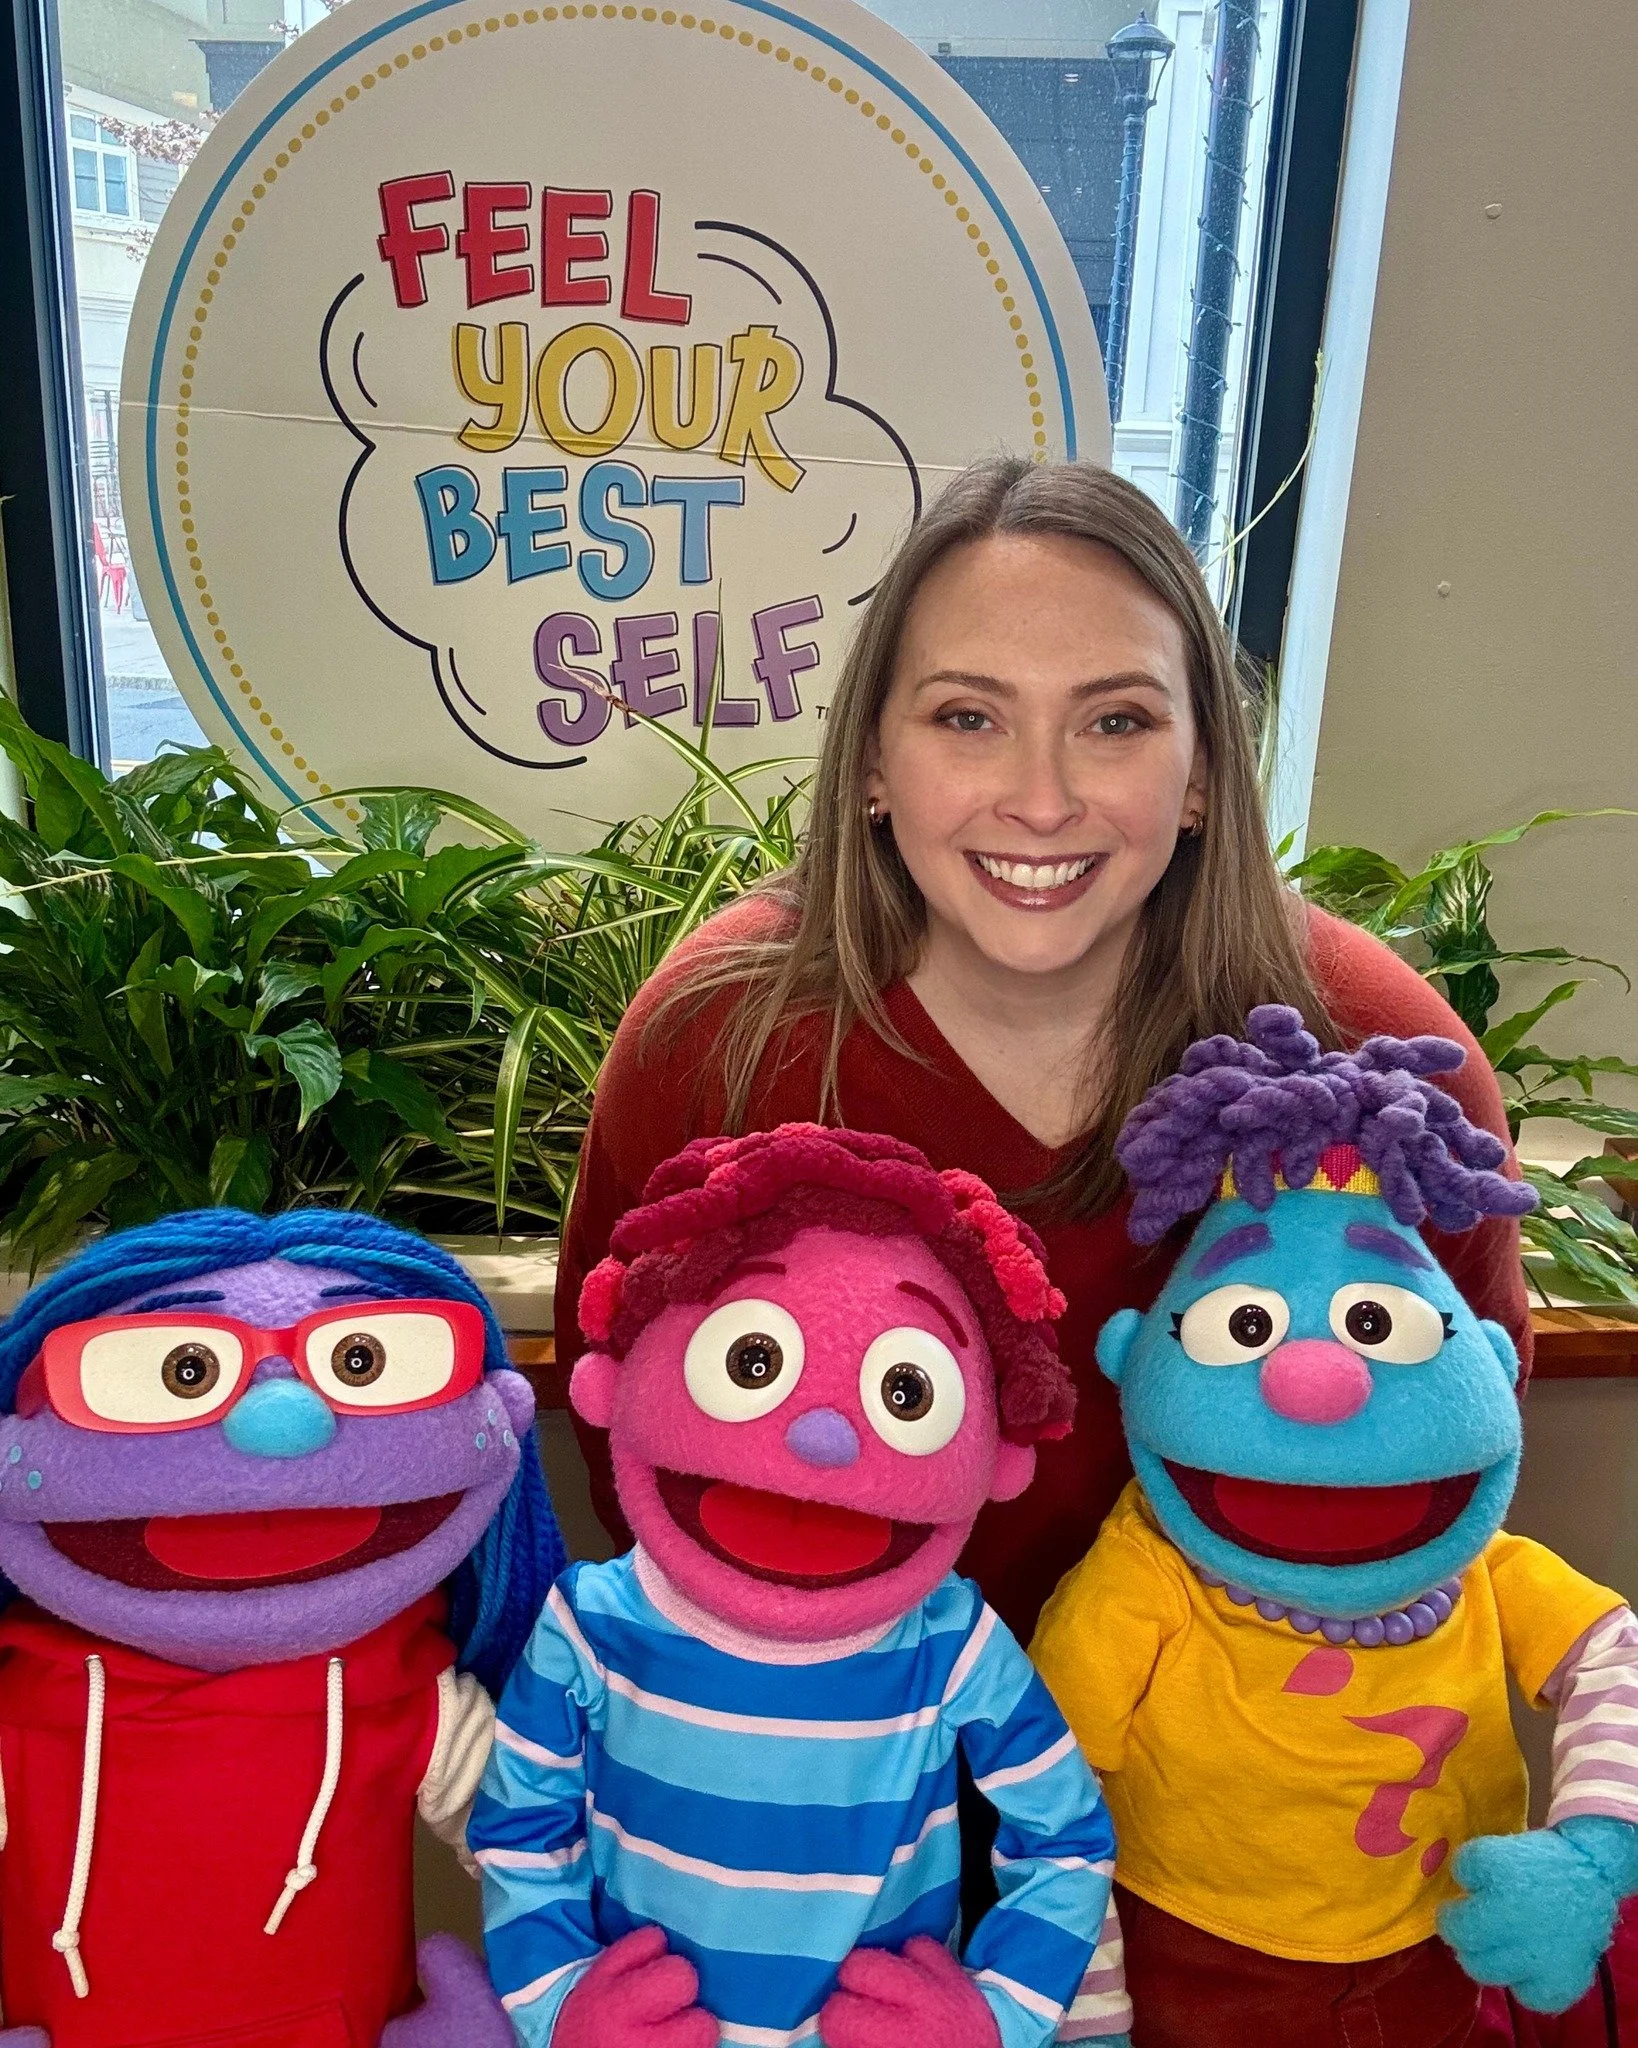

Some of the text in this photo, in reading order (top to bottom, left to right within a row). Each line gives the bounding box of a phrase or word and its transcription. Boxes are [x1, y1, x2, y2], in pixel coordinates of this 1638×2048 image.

[378, 171, 692, 326] FEEL
[452, 322, 806, 494] YOUR
[415, 459, 746, 602] BEST
[533, 594, 824, 746] SELF
